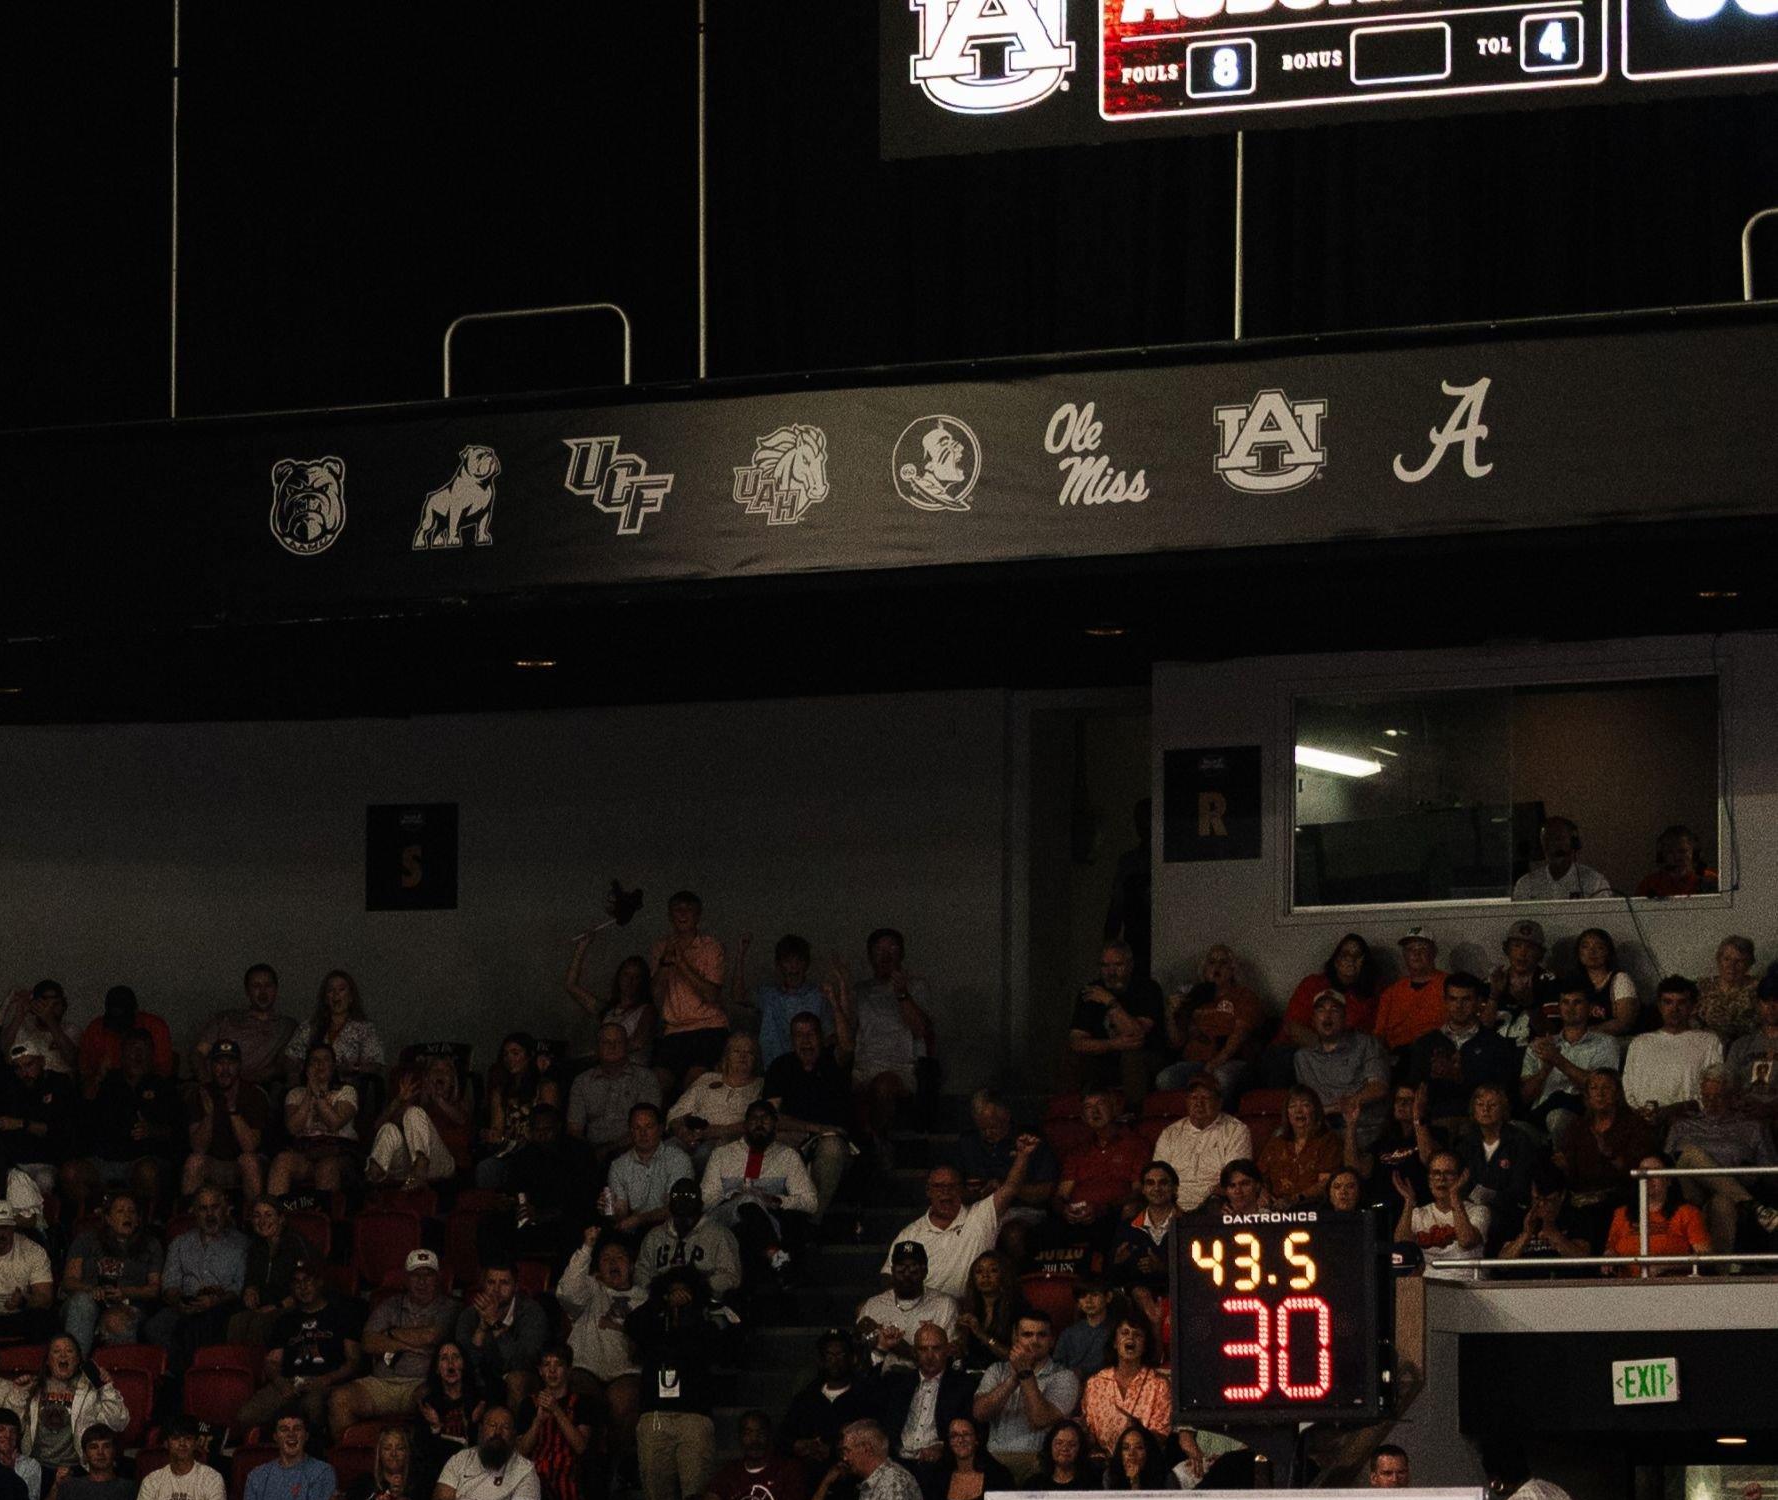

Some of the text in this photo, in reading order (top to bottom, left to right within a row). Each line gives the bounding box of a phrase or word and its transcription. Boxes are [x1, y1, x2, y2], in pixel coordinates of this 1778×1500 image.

[1121, 20, 1566, 87] FOULS 8 BONUS TOL 4
[1045, 401, 1104, 454] Ole
[562, 435, 676, 536] UCF
[733, 465, 806, 526] UAH
[1058, 455, 1151, 507] Miss
[1198, 792, 1228, 837] R
[401, 845, 423, 889] S
[1222, 1212, 1318, 1226] DAKTRONICS
[1191, 1232, 1316, 1292] 43.5
[1224, 1297, 1331, 1400] 30
[1625, 1364, 1668, 1399] EXIT
